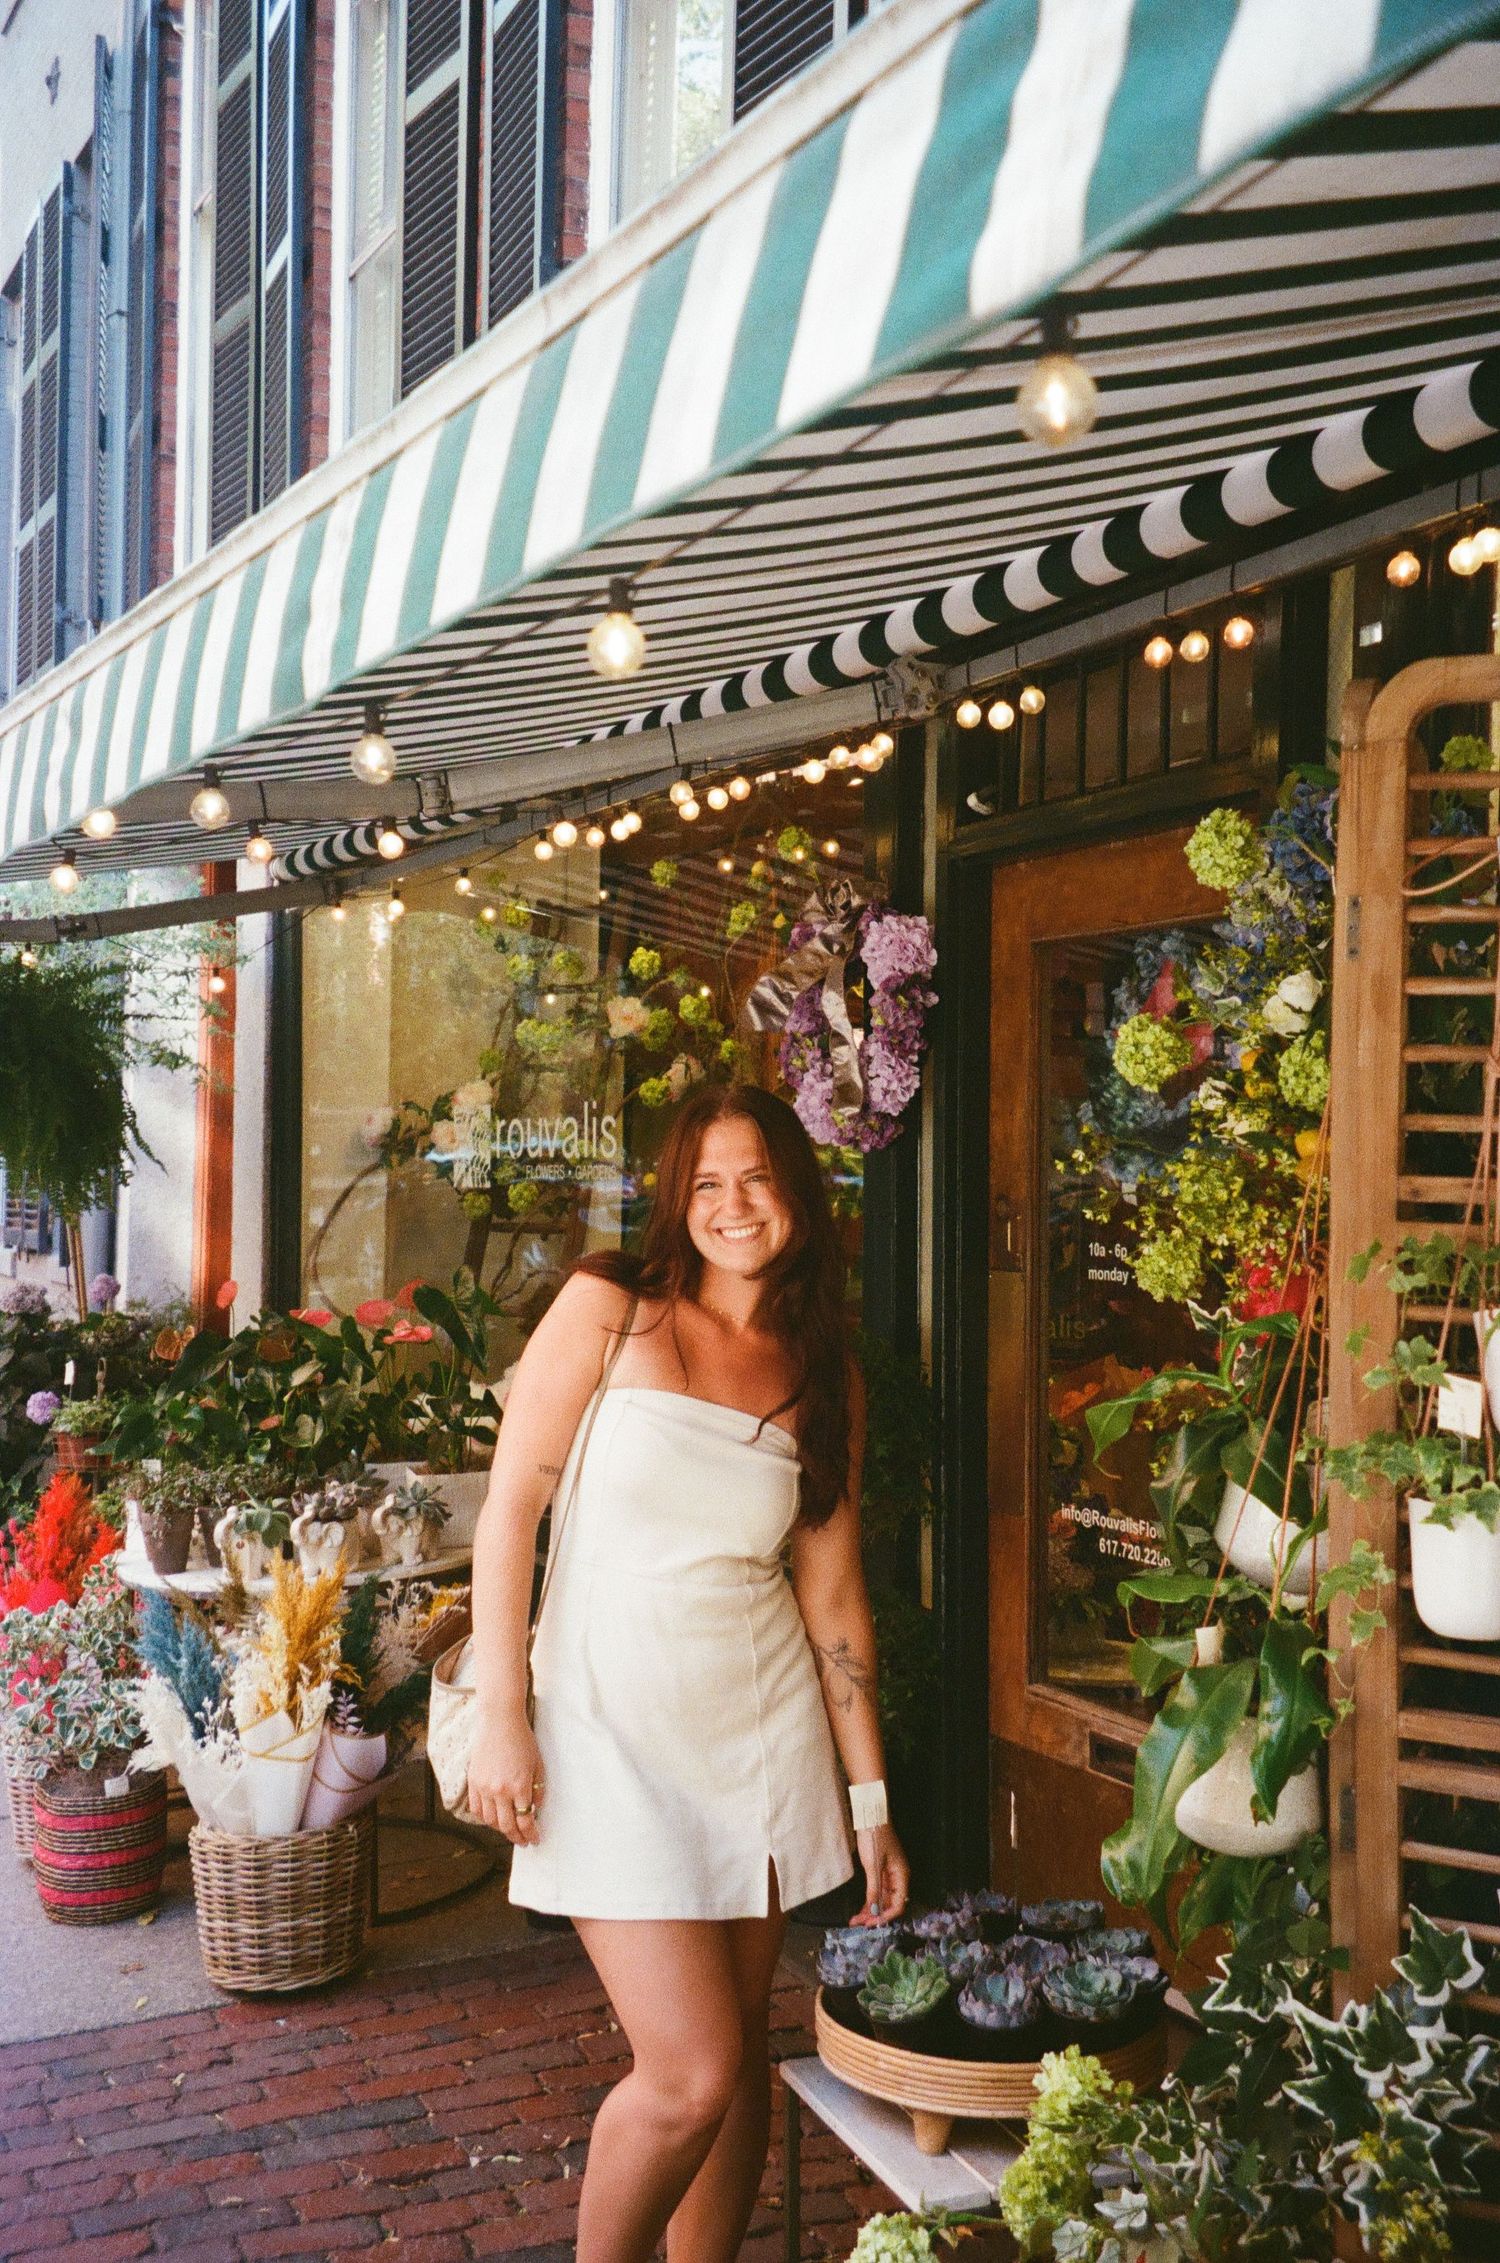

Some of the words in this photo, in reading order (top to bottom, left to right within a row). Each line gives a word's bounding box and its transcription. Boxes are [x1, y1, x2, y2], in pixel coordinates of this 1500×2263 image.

[496, 1100, 617, 1159] rouvalis
[525, 1164, 566, 1180] FLOWERS
[1088, 1242, 1106, 1258] 10a
[1114, 1243, 1128, 1261] 6p
[1088, 1267, 1129, 1286] monday
